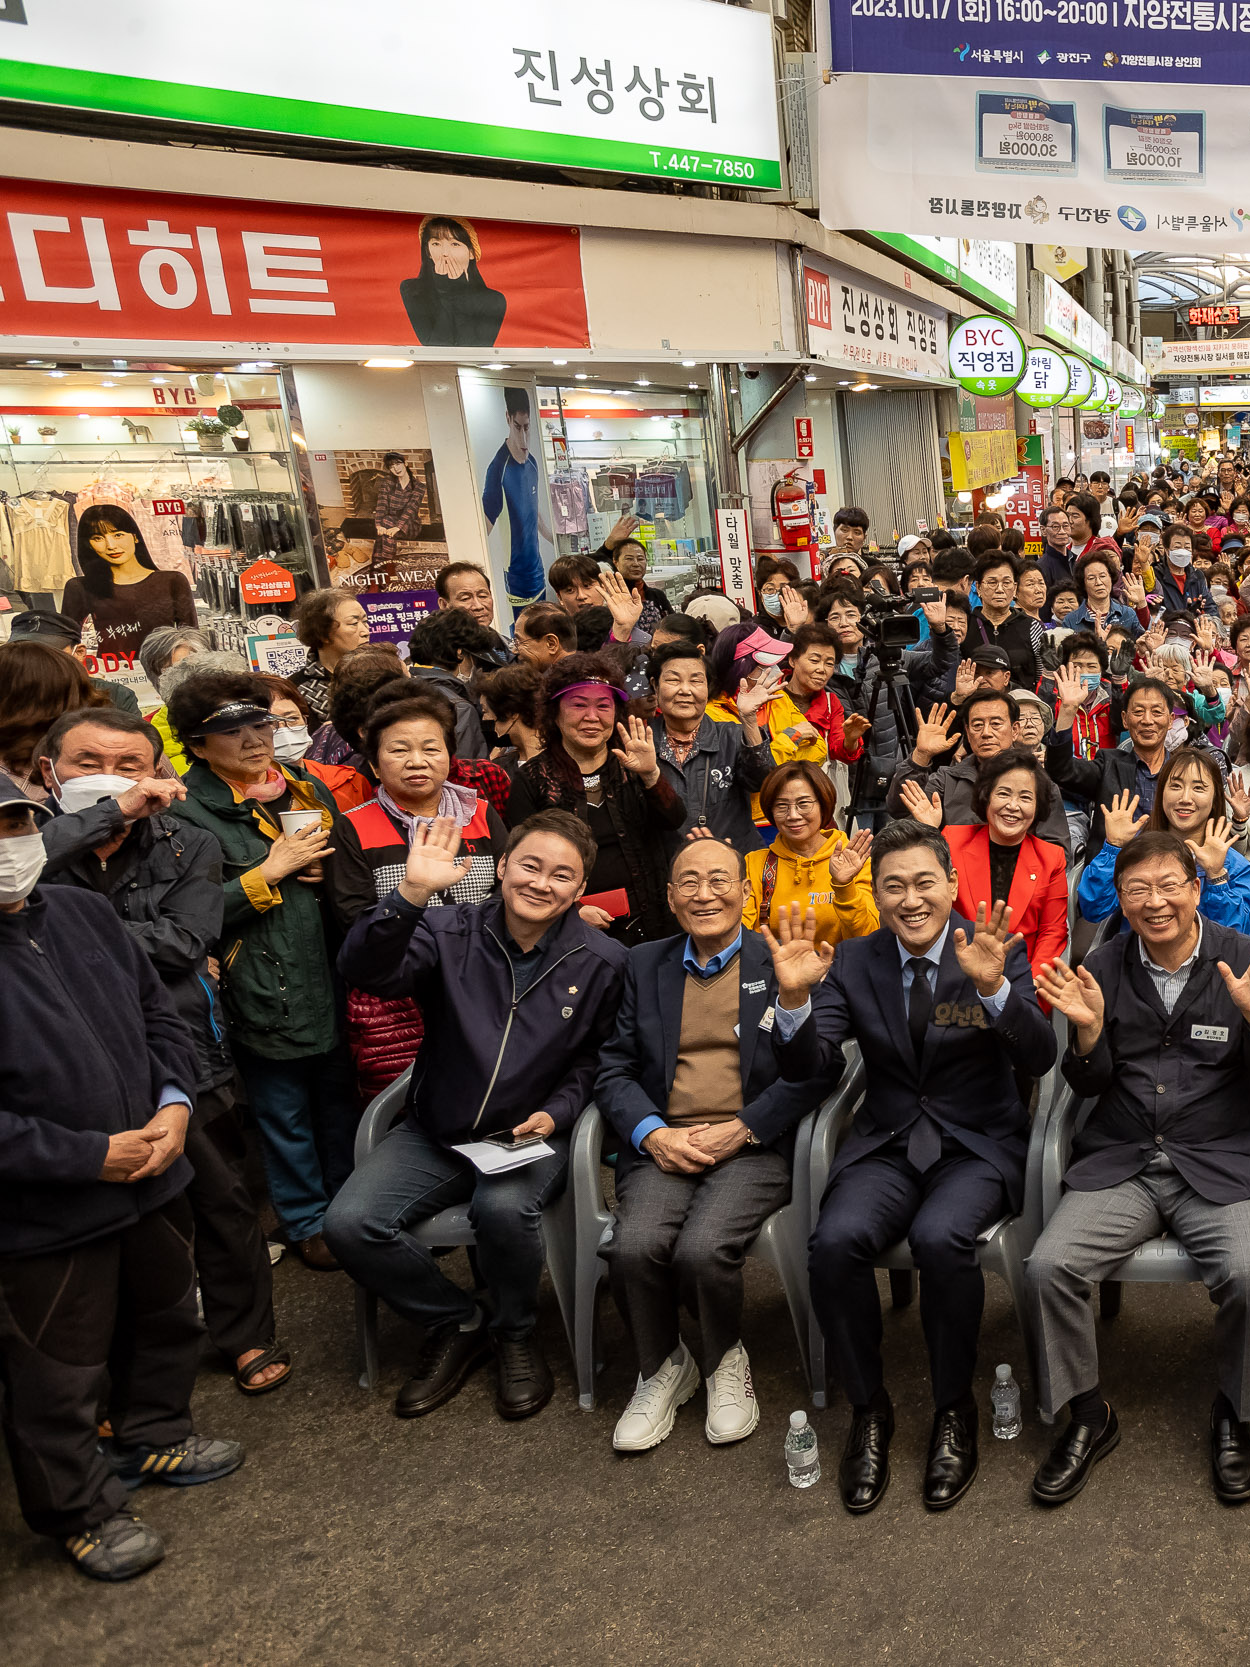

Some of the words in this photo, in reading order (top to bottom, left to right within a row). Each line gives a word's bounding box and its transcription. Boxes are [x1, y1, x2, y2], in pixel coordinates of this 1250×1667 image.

[852, 0, 949, 19] 2023.10.17
[957, 0, 991, 23] (화)
[997, 0, 1107, 25] 16:00~20:00
[971, 49, 1024, 64] 서울특별시
[1056, 52, 1092, 64] 광진구
[1121, 54, 1173, 67] 자양전통시장
[1175, 57, 1201, 68] 상인회
[512, 46, 717, 125] 진성상회
[649, 151, 755, 179] T.447-7850
[0, 211, 336, 316] 디히트
[807, 277, 829, 324] BYC
[841, 285, 899, 345] 진성상회
[906, 310, 937, 355] 직영점
[965, 329, 1004, 346] BYC
[957, 350, 1014, 373] 직영점
[1031, 357, 1052, 370] 하림
[1033, 371, 1049, 389] 닭
[152, 387, 197, 405] BYC
[156, 501, 183, 513] BYC
[1005, 500, 1031, 517] 오리
[725, 516, 740, 550] 타월
[338, 572, 389, 588] NIGHT
[729, 557, 745, 590] 맞춤
[368, 613, 395, 624] 귀여운
[105, 621, 142, 640] 부탁해!
[83, 650, 136, 675] ODY
